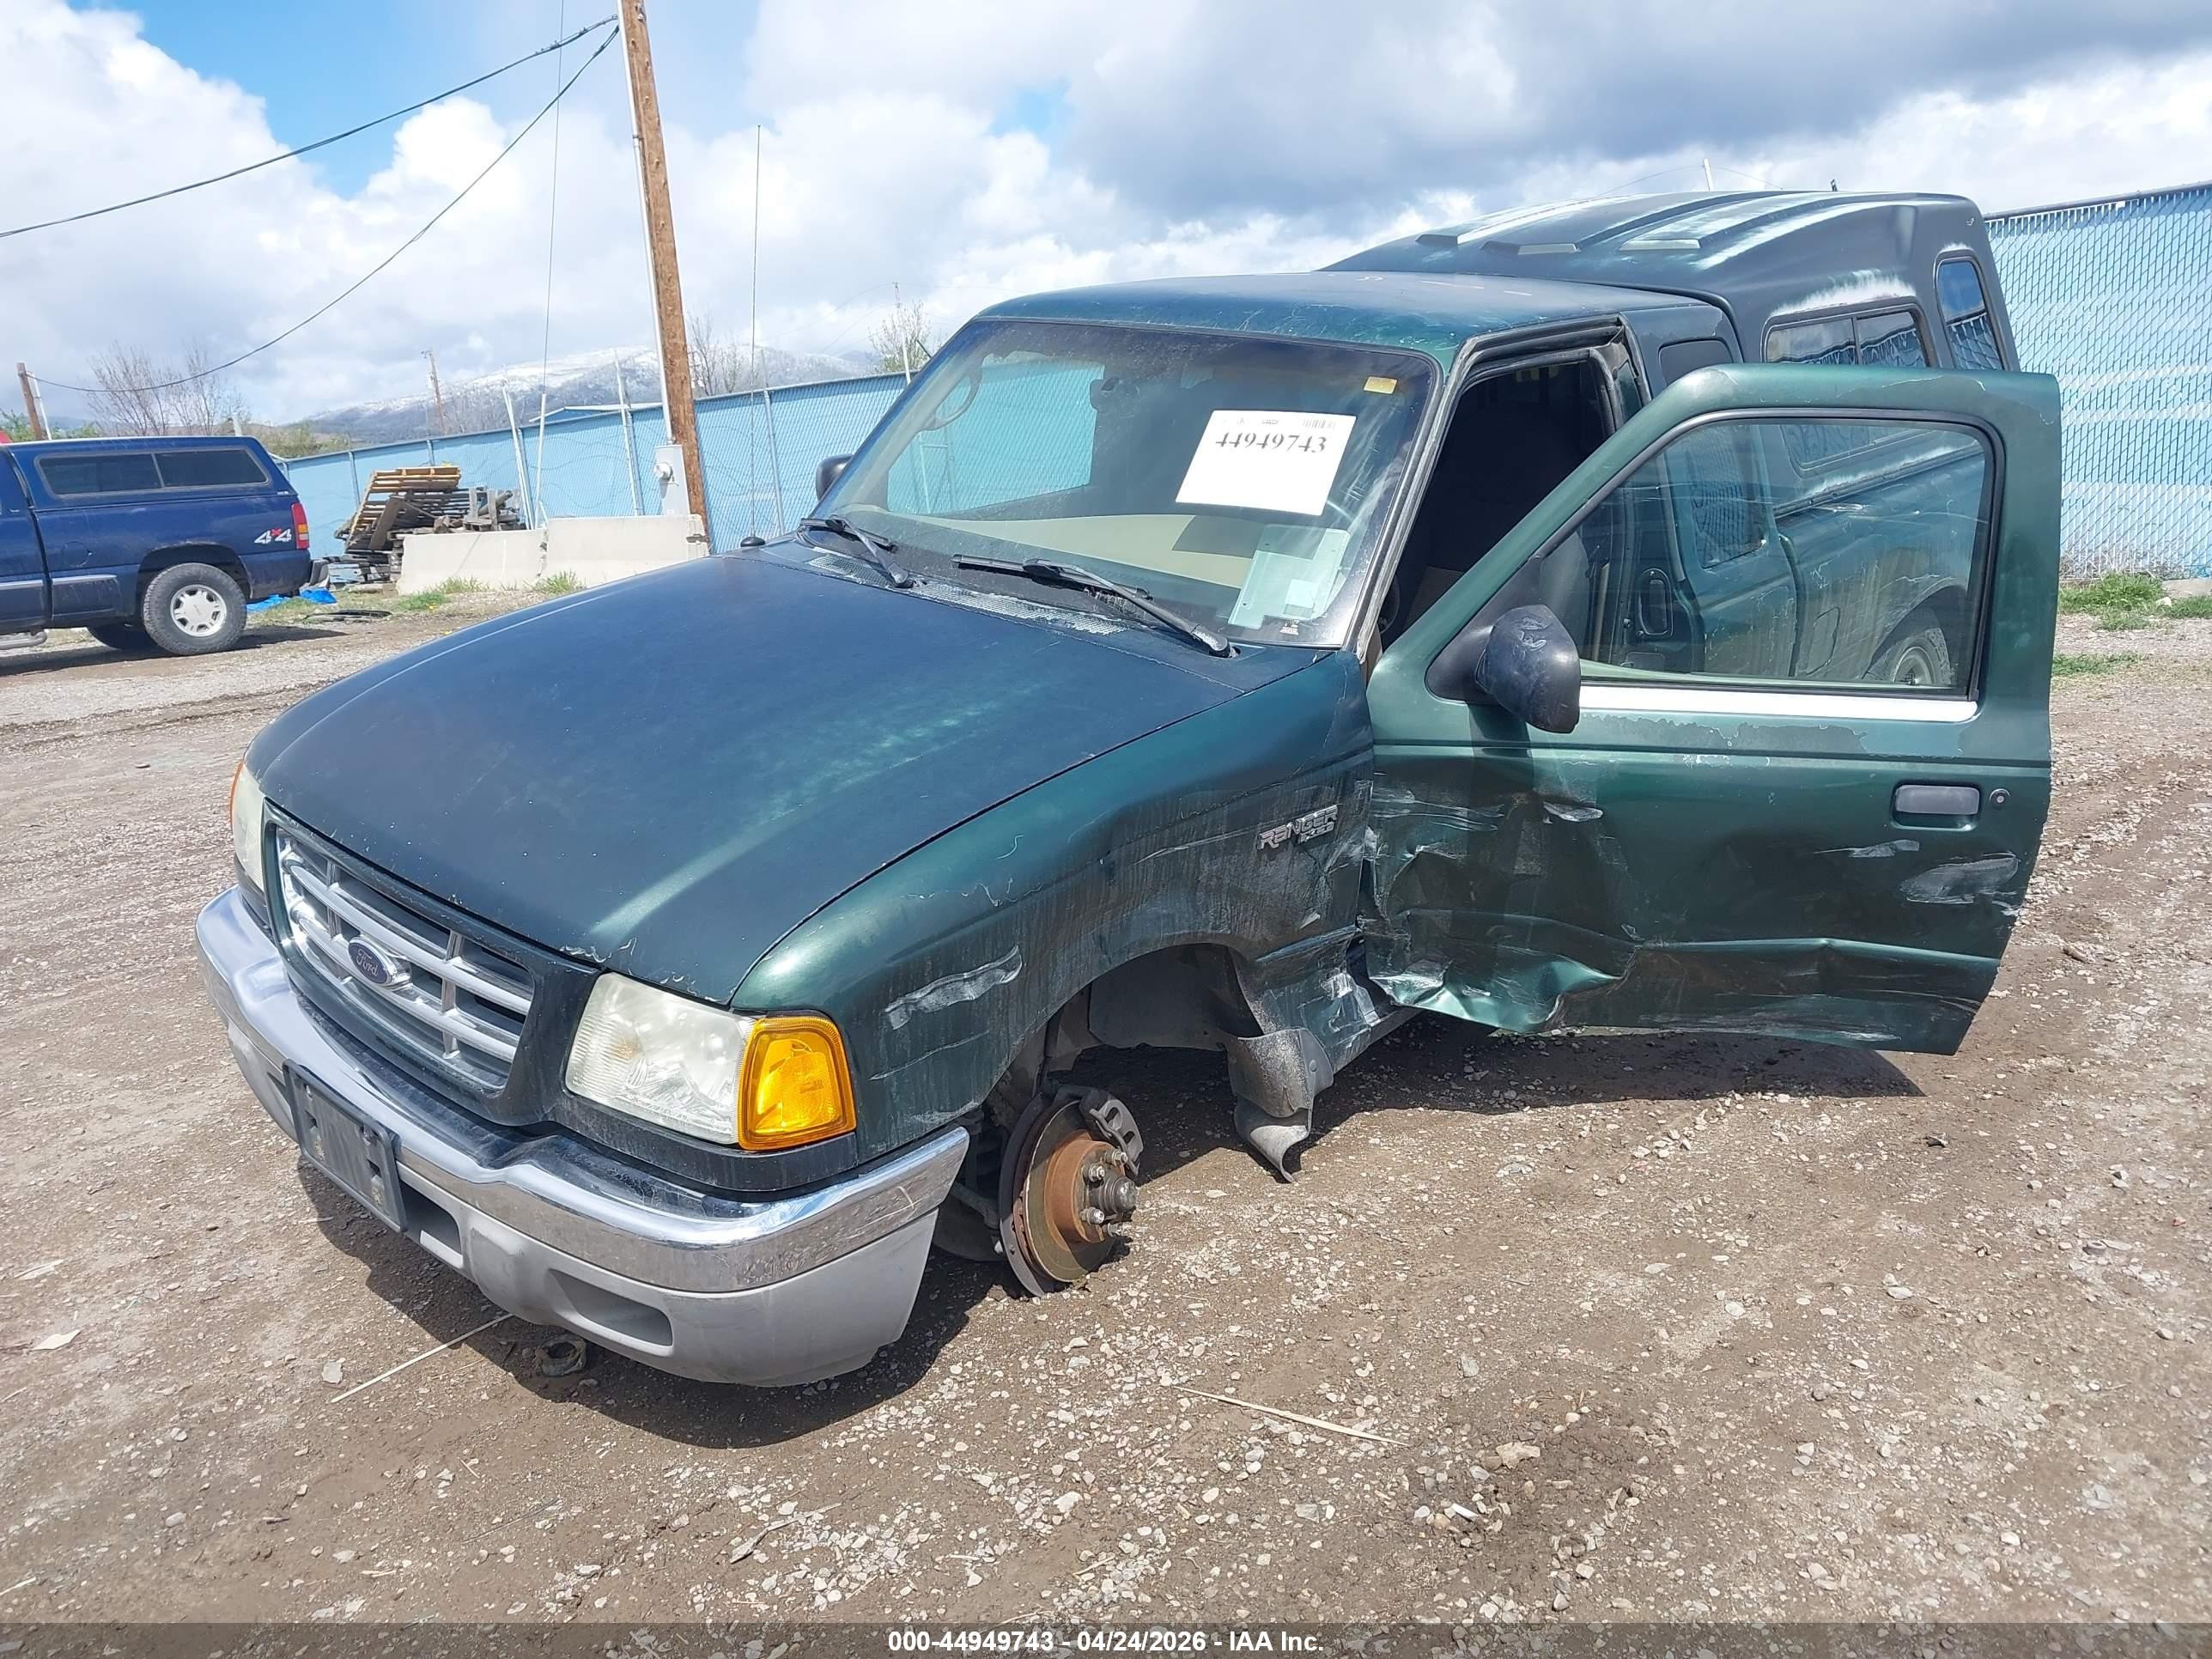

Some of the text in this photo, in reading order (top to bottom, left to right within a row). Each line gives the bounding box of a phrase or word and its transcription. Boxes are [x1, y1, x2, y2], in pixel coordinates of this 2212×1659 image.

[1216, 432, 1327, 453] 44949743
[1257, 805, 1338, 850] RANGER
[356, 949, 379, 977] Ford
